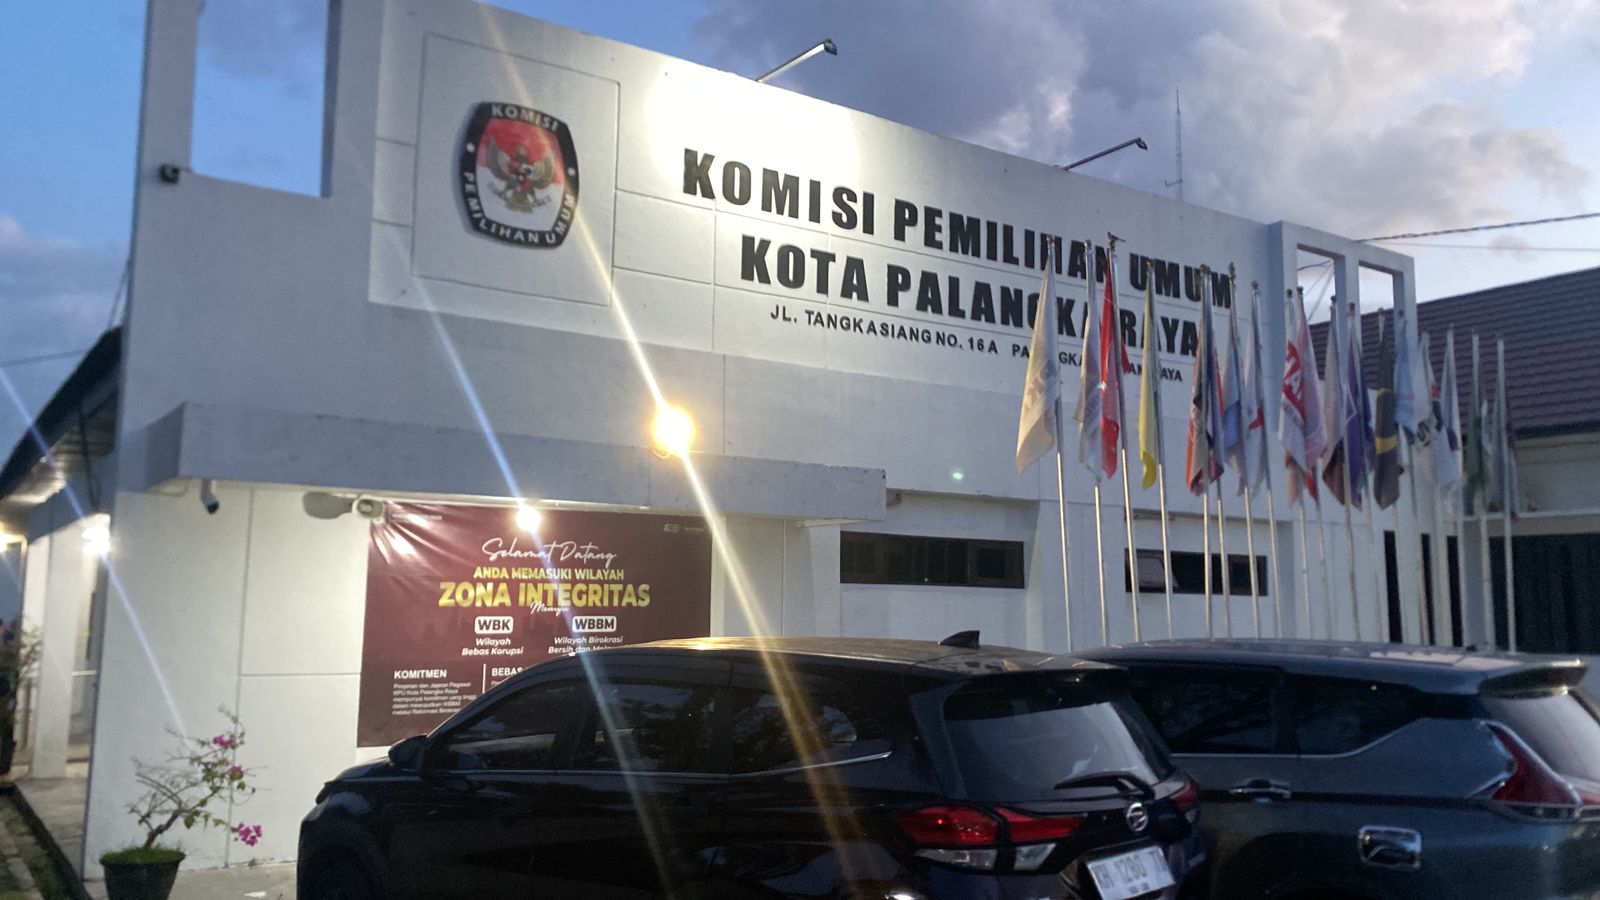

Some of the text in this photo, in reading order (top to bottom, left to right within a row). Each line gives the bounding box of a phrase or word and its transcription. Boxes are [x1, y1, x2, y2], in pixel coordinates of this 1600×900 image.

[491, 105, 559, 131] KOMISI
[464, 172, 575, 244] PEMILIHAN UMUM
[683, 148, 1231, 309] KOMISI PEMILIHAN UMUM
[741, 233, 869, 302] KOTA
[770, 304, 798, 323] JL.
[804, 309, 932, 344] TANGKASIANG
[935, 331, 964, 350] NO.
[482, 537, 617, 568] Selamat Datang
[473, 566, 624, 580] ANDA MEMASUKI WILAYAH
[438, 581, 650, 608] ZONA INTEGRITAS
[477, 619, 511, 631] WBK
[574, 618, 614, 630] WBBM
[475, 637, 511, 647] Wilayah
[554, 635, 624, 646] Wilayah Birokrasi
[461, 646, 524, 656] Bebas Korupsi
[548, 646, 574, 654] Bersih
[394, 669, 447, 679] KOMITMEN
